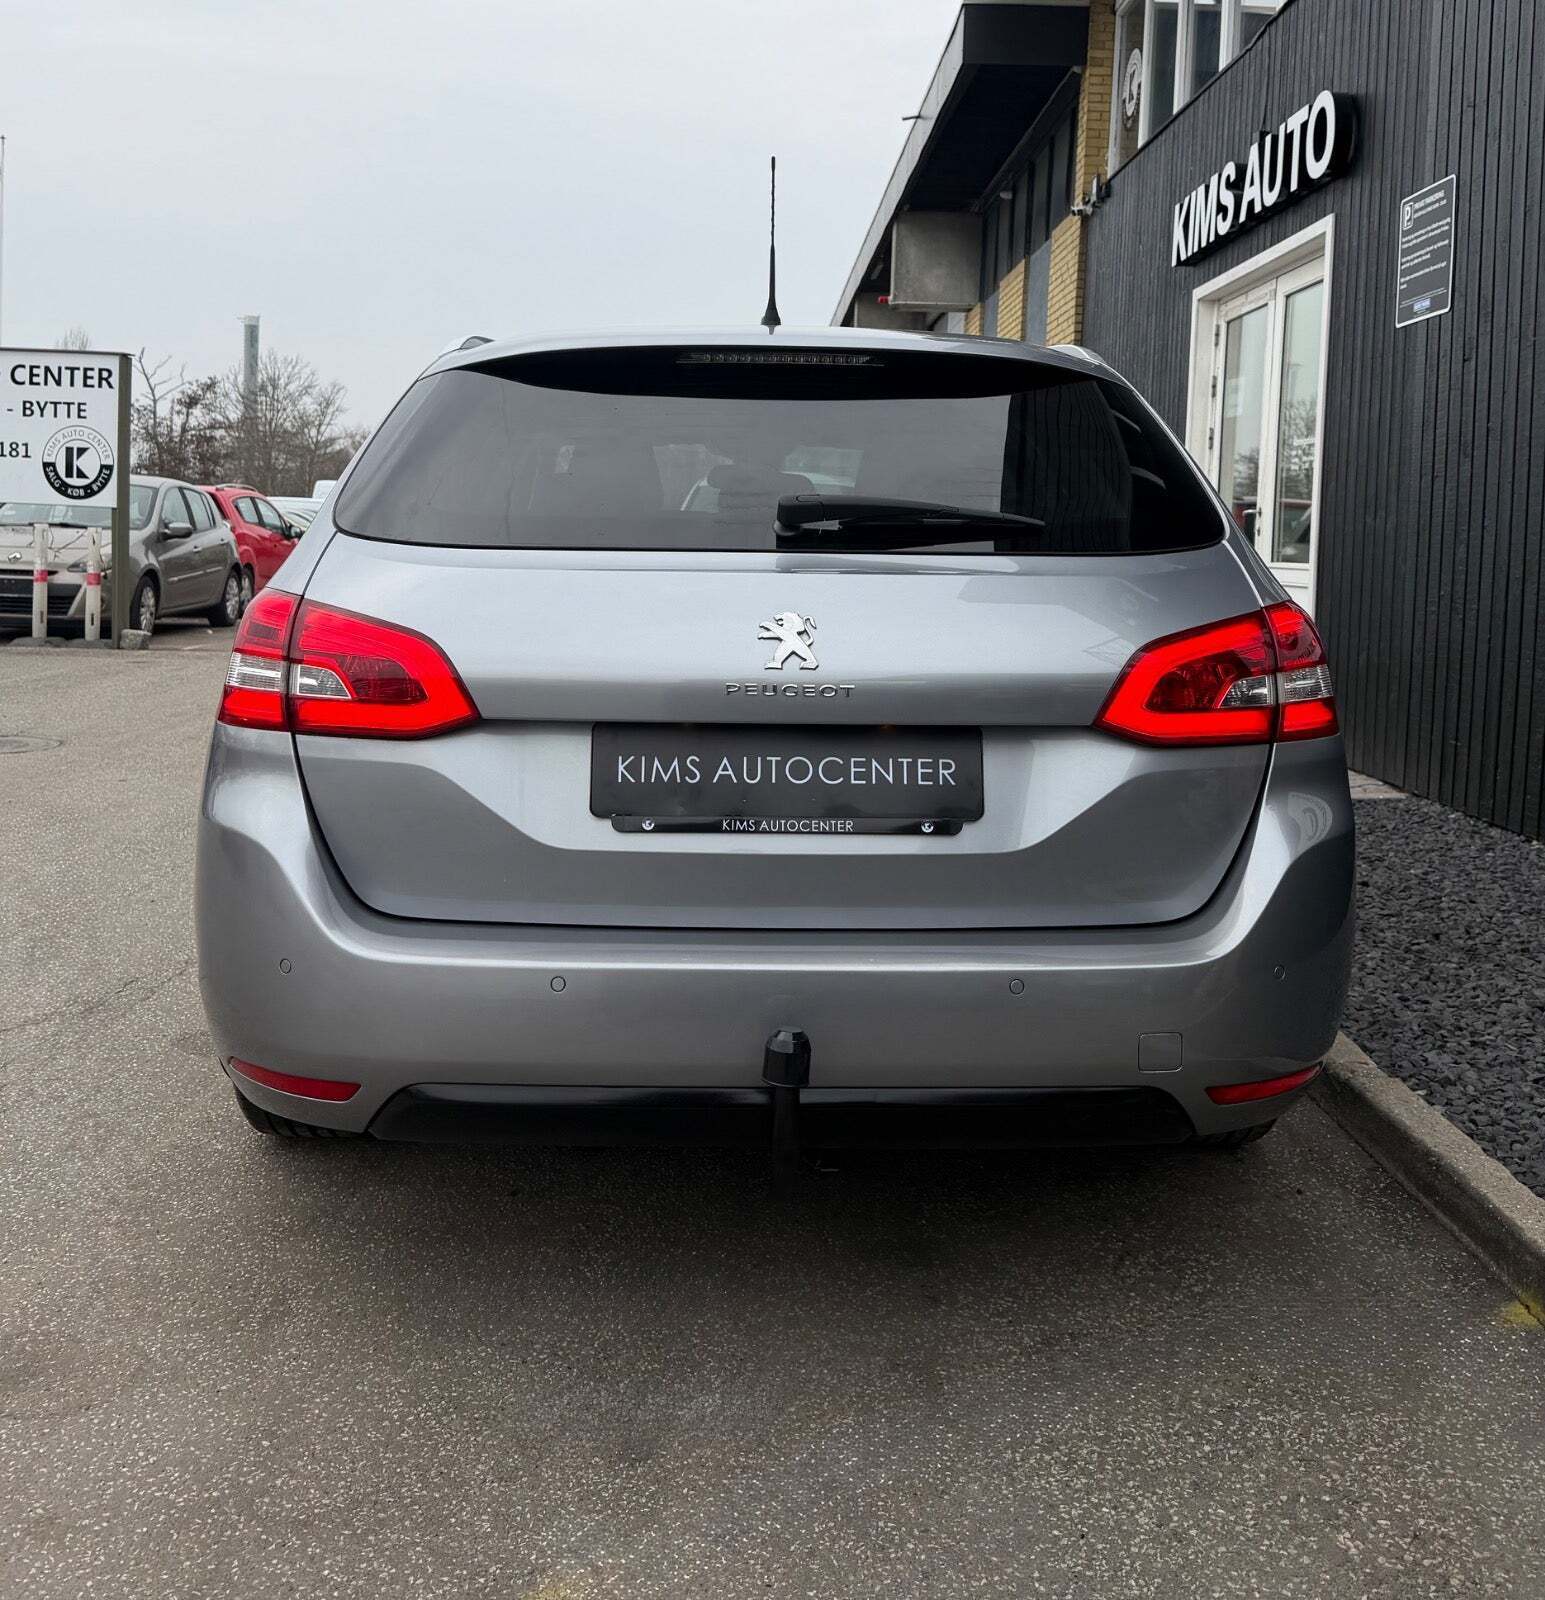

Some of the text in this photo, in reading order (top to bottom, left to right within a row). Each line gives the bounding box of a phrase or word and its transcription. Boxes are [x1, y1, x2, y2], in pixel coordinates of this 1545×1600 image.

[1171, 90, 1336, 267] KIMS AUTO
[10, 364, 114, 389] CENTER
[22, 400, 87, 419] BYTTE
[0, 441, 31, 458] 181
[62, 429, 85, 440] AUTO
[87, 432, 110, 460] CENTER
[65, 446, 90, 479] K
[46, 466, 61, 487] SALG
[92, 467, 110, 492] BYTTE
[725, 682, 855, 697] PEUGEOT
[617, 755, 957, 785] KIMS AUTOCENTER
[722, 819, 854, 832] KIMS AUTOCENTER
